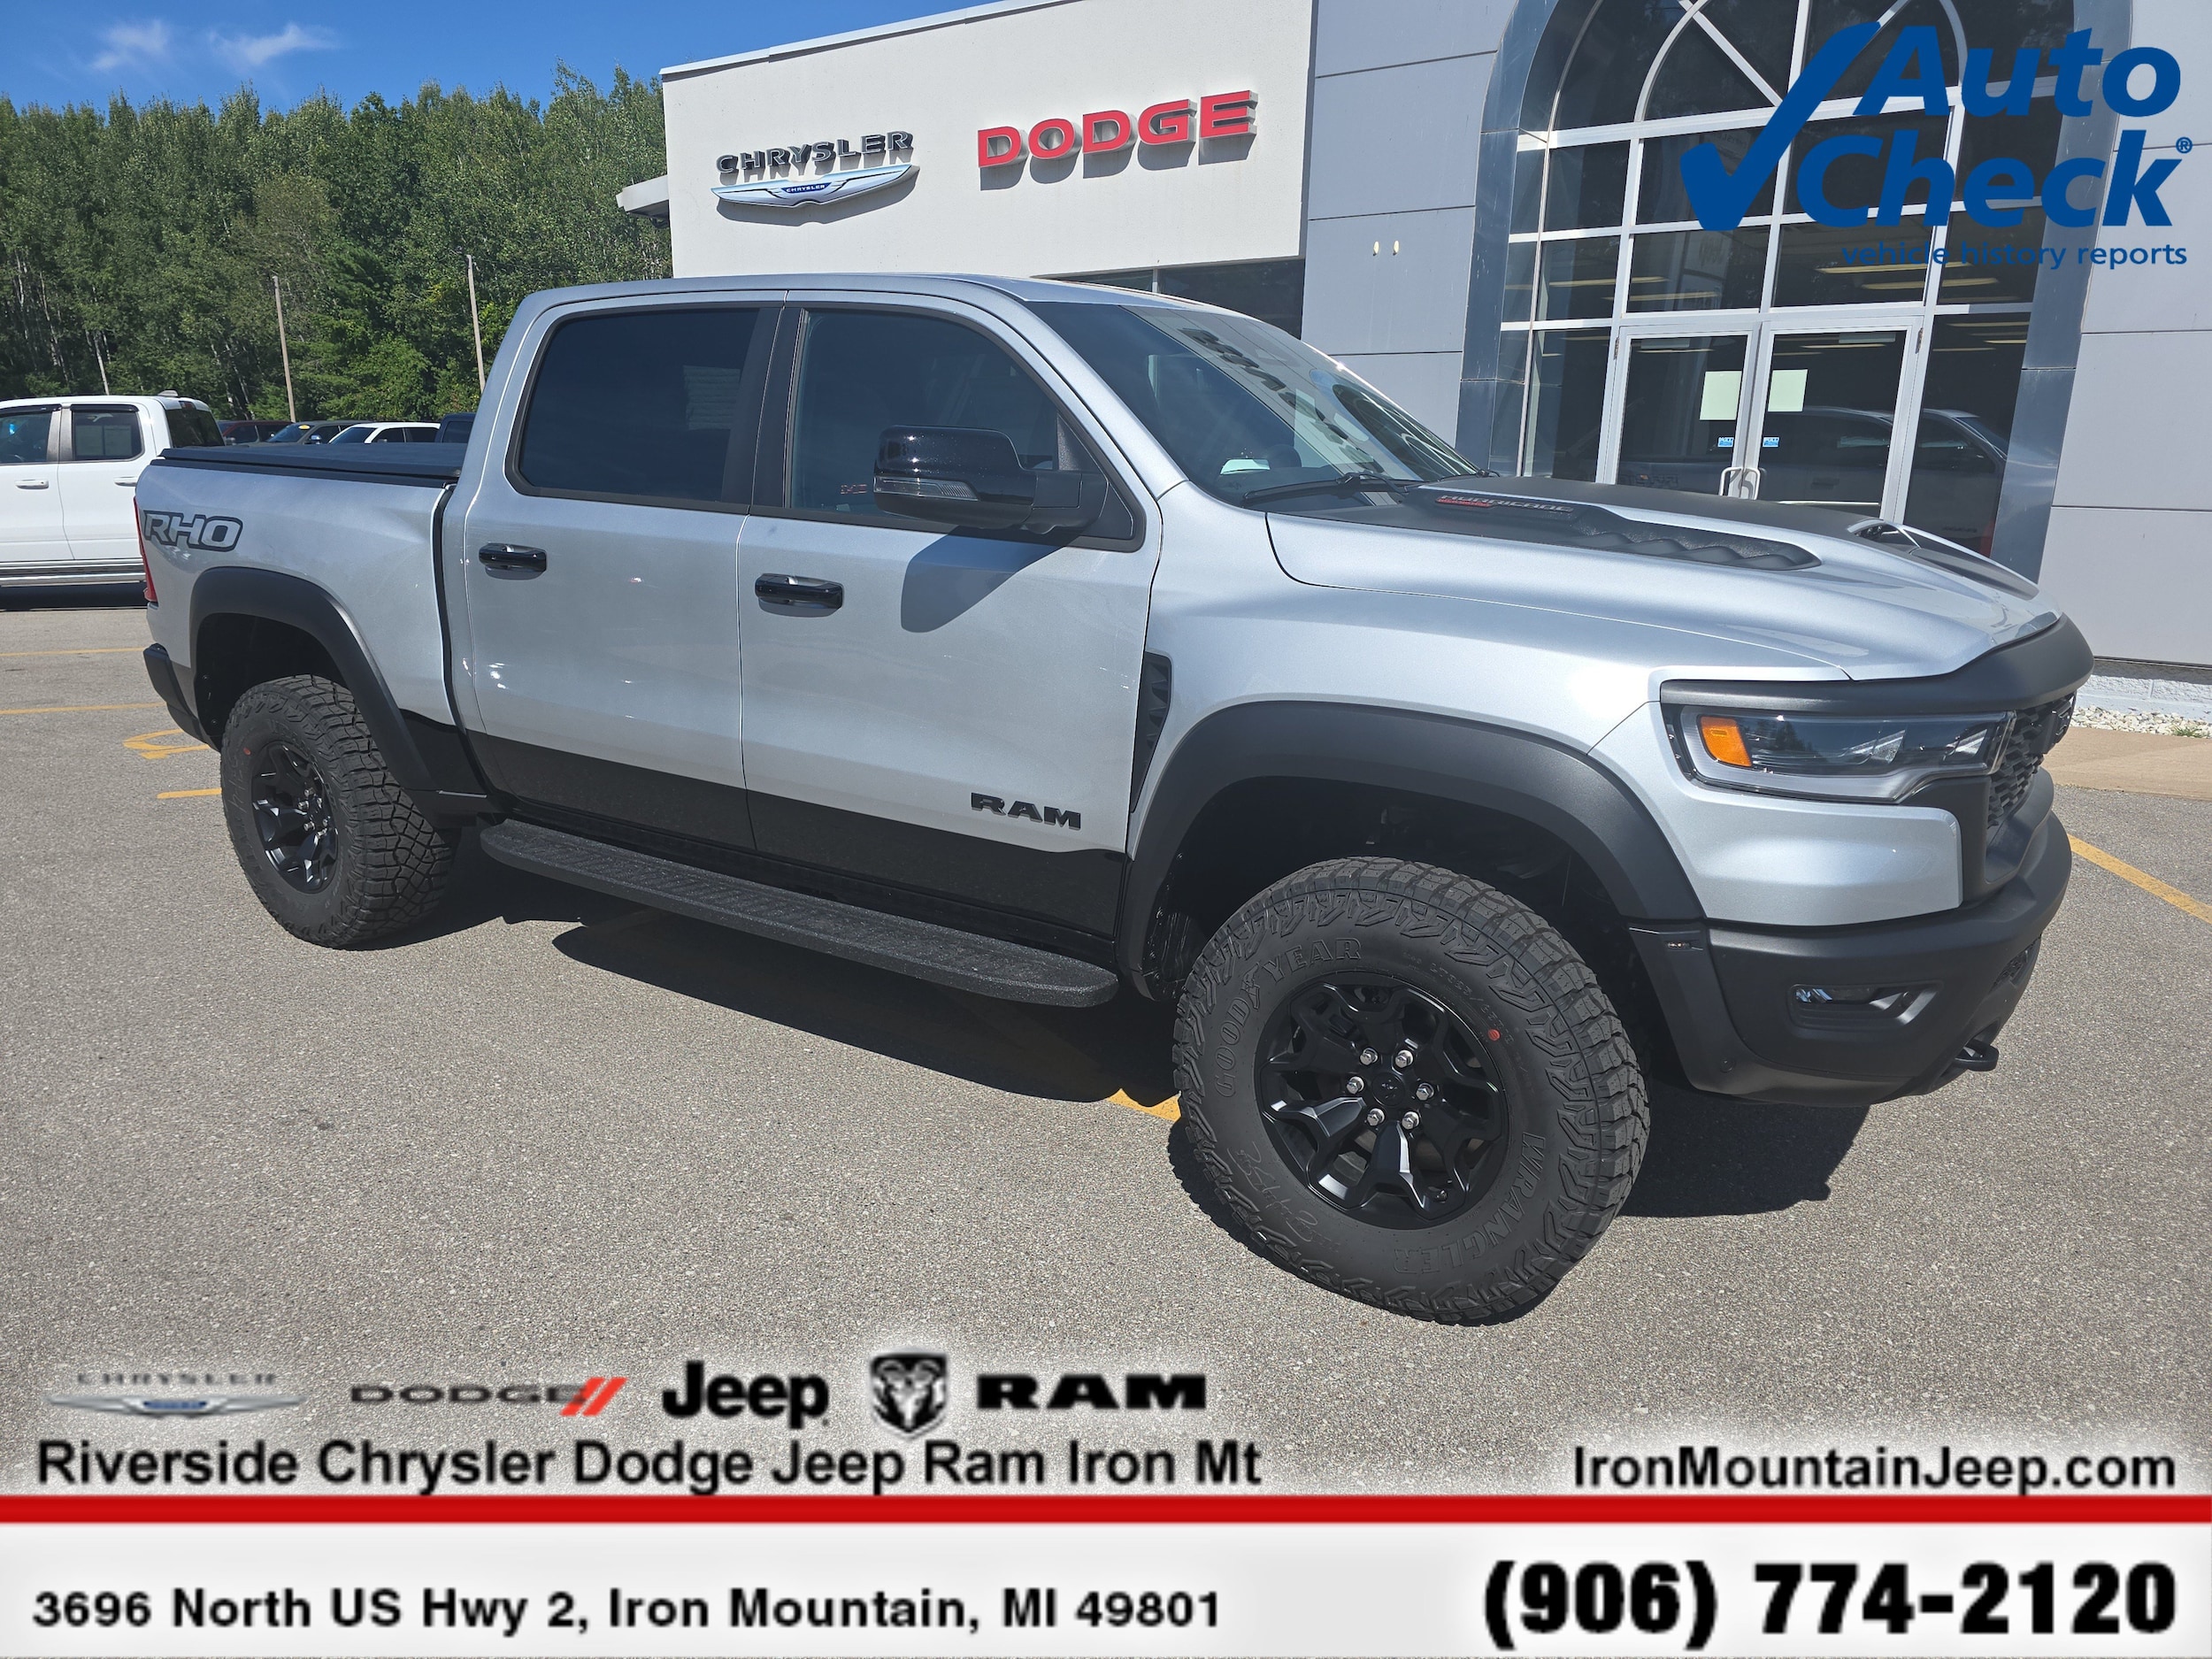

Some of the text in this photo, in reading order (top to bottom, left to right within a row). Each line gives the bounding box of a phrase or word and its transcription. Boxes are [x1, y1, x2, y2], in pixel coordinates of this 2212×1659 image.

[978, 89, 1257, 167] DODGE
[716, 130, 913, 173] CHRYSLER
[786, 184, 826, 193] CHRYSLER
[142, 510, 243, 552] RHO
[971, 793, 1081, 830] RAM
[1394, 1131, 1546, 1274] WRANGLER
